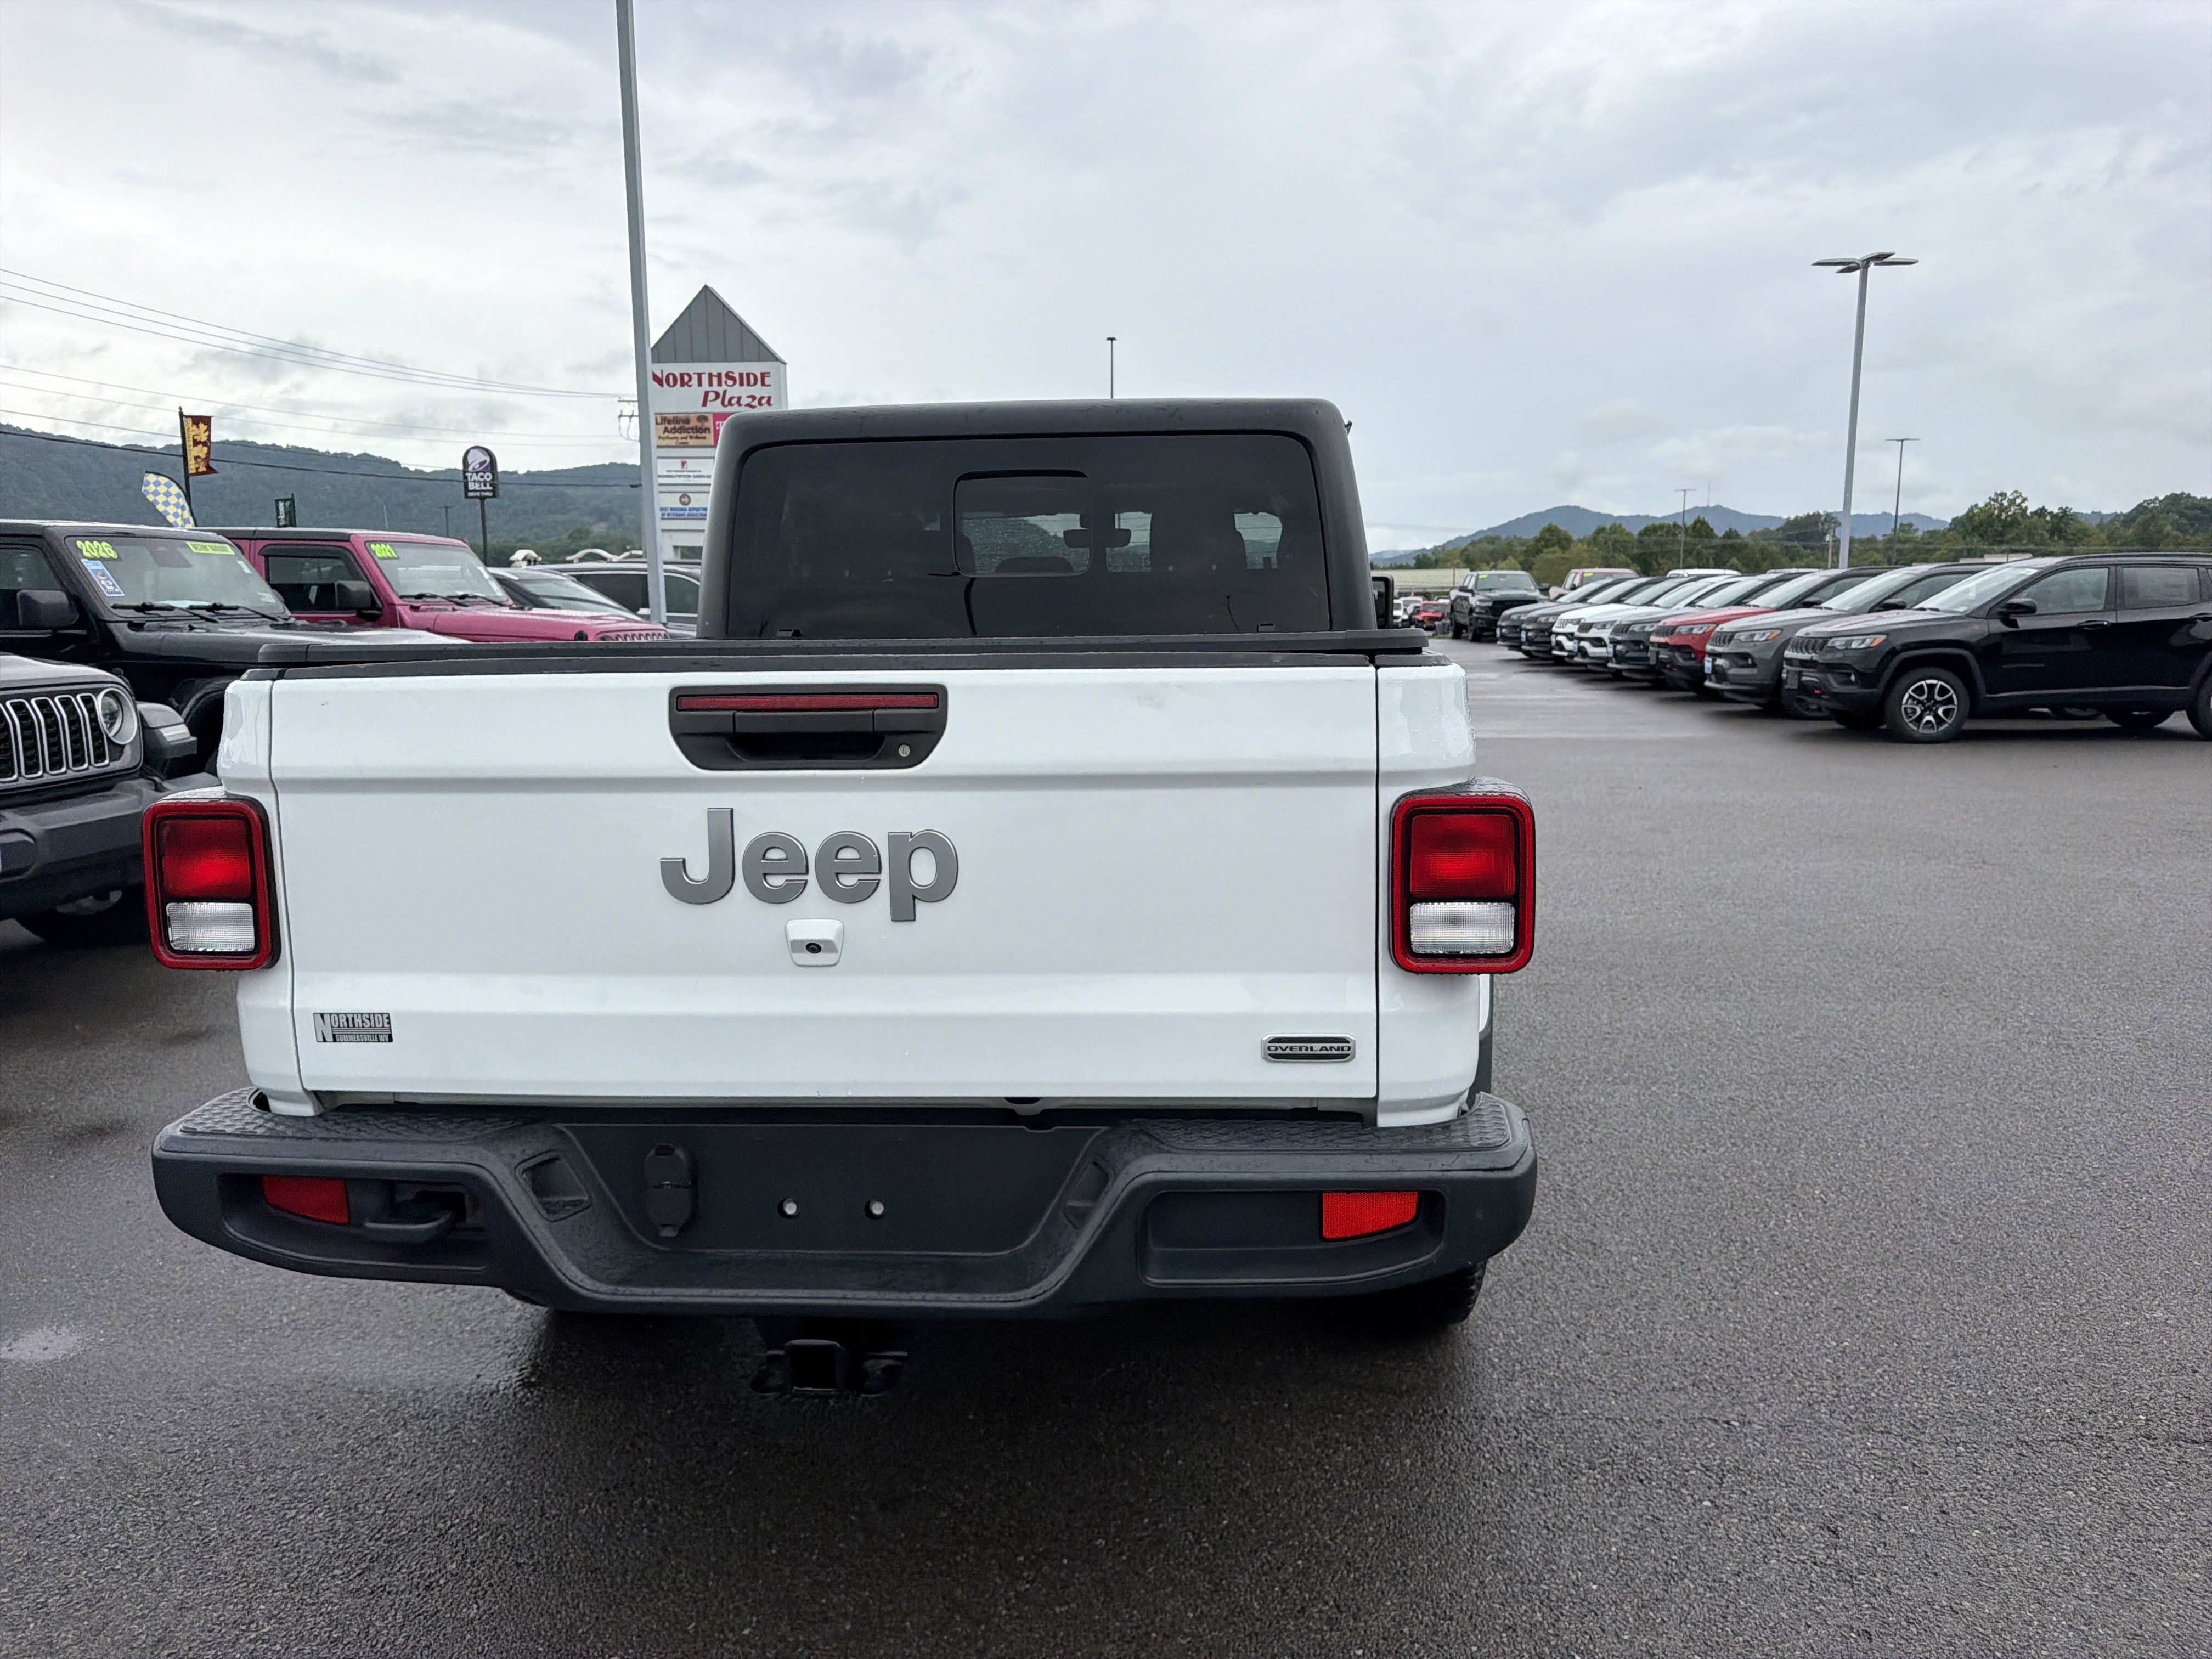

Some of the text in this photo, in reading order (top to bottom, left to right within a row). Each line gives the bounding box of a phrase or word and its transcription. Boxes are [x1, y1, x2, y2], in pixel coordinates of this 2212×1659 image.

[652, 369, 771, 387] NORTHSIDE
[702, 389, 773, 409] Plaza
[663, 425, 711, 435] Addiction
[465, 472, 493, 482] TACO
[468, 482, 493, 490] BELL
[76, 540, 118, 558] 2026
[660, 807, 958, 921] Jeep
[313, 1014, 390, 1042] NORTHSIDE
